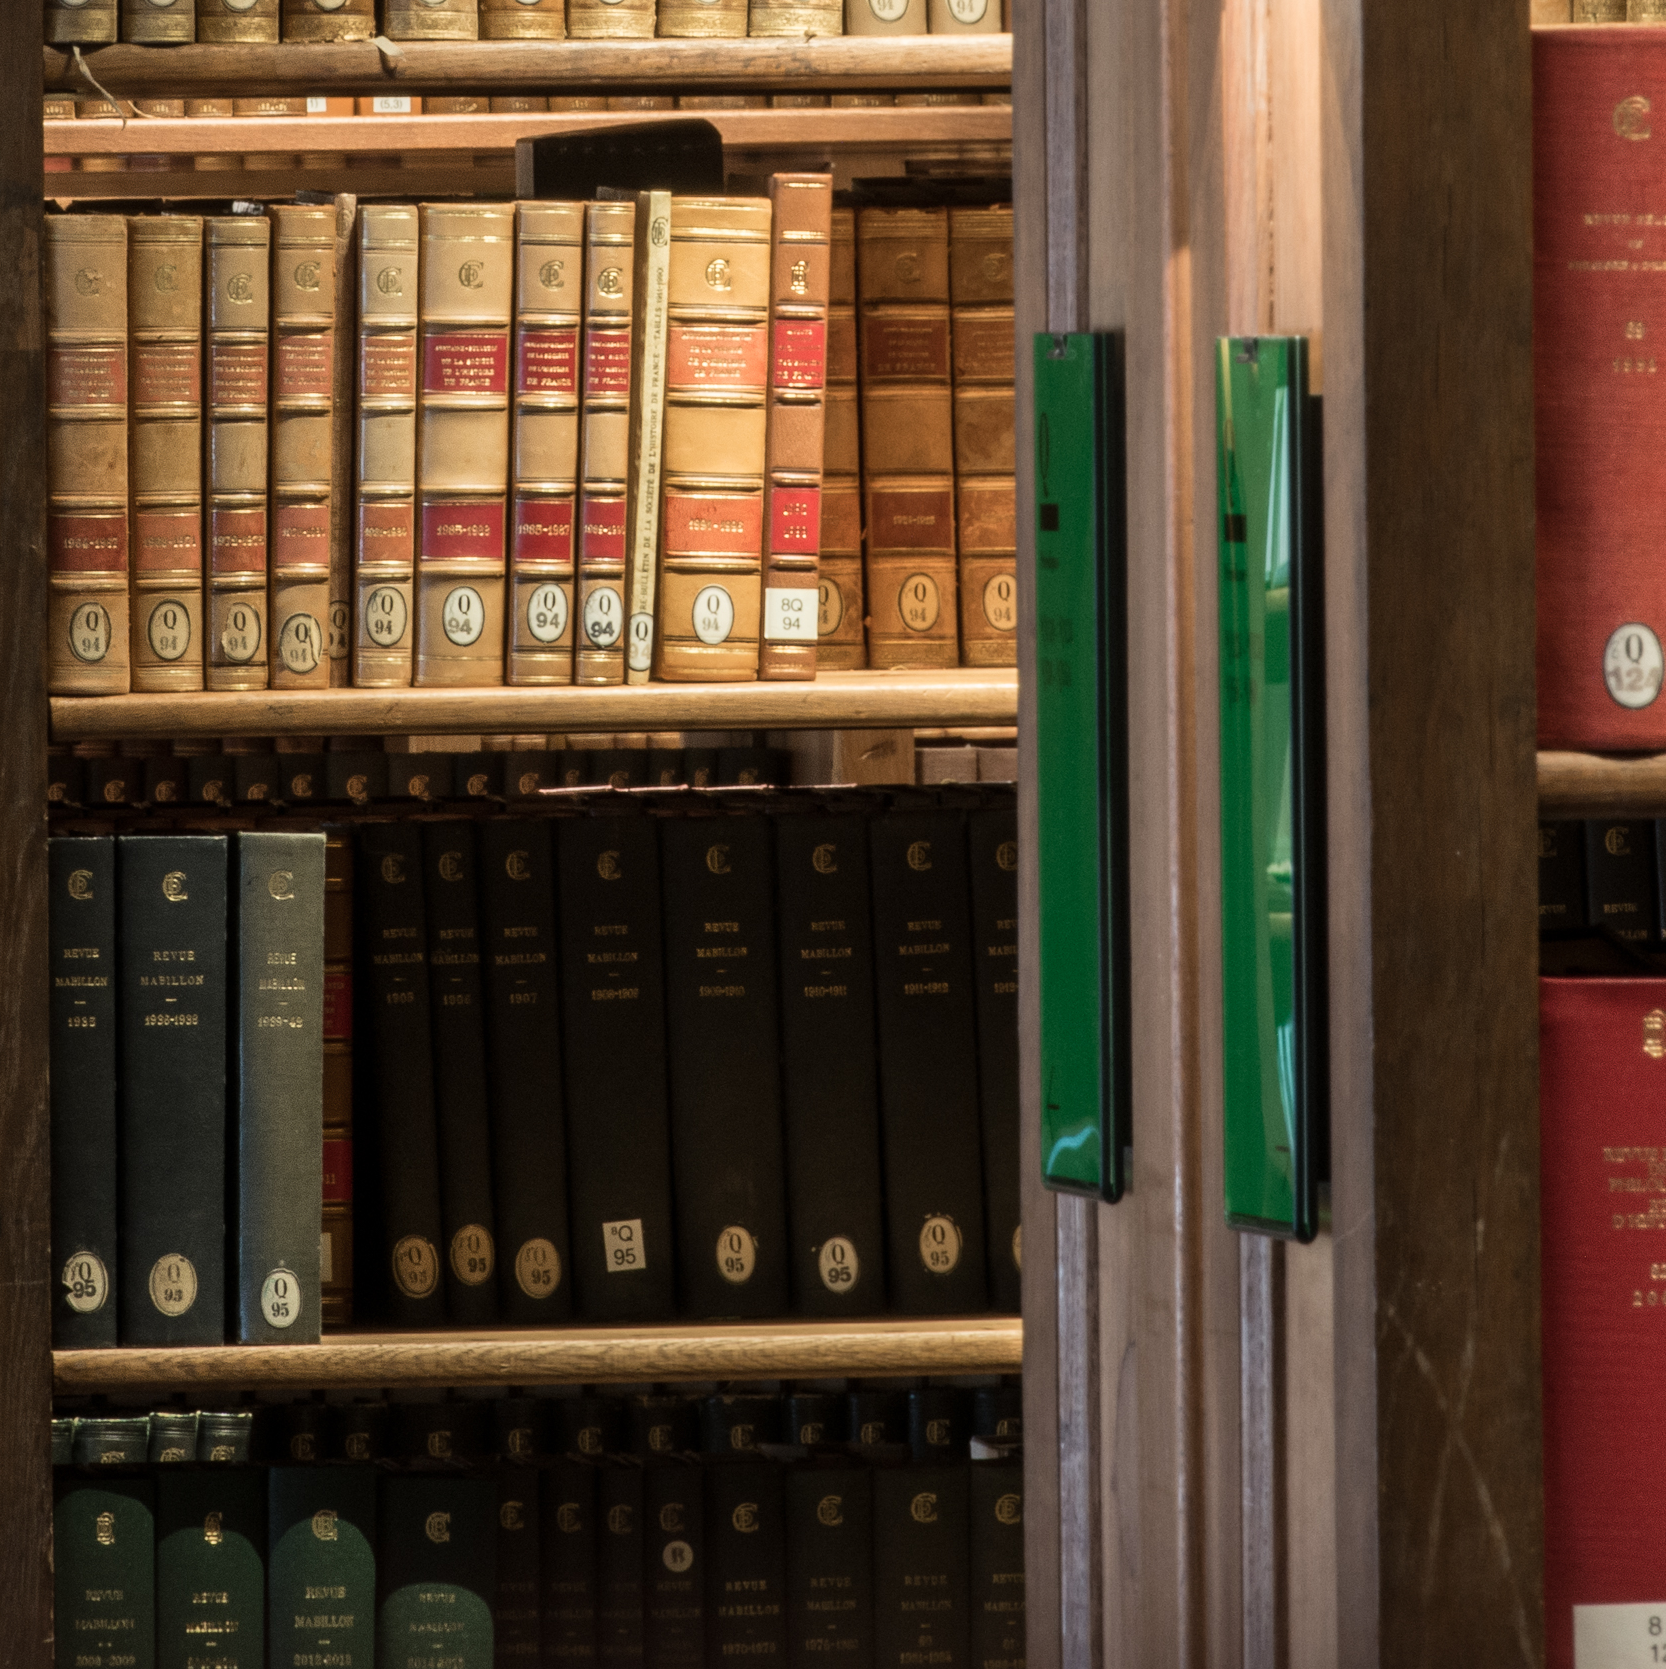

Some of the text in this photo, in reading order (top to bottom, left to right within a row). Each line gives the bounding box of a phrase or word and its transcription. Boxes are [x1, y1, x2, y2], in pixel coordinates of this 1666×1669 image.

[781, 599, 803, 612] 8Q
[536, 612, 559, 628] 94
[783, 618, 800, 629] 94
[66, 949, 99, 958] REVUE
[154, 950, 194, 961] REVUE
[142, 975, 204, 986] MABILLON
[614, 1248, 636, 1265] 95
[829, 1267, 851, 1283] 95
[71, 1279, 96, 1298] 95
[272, 1303, 289, 1316] 95
[1649, 1617, 1661, 1635] 8
